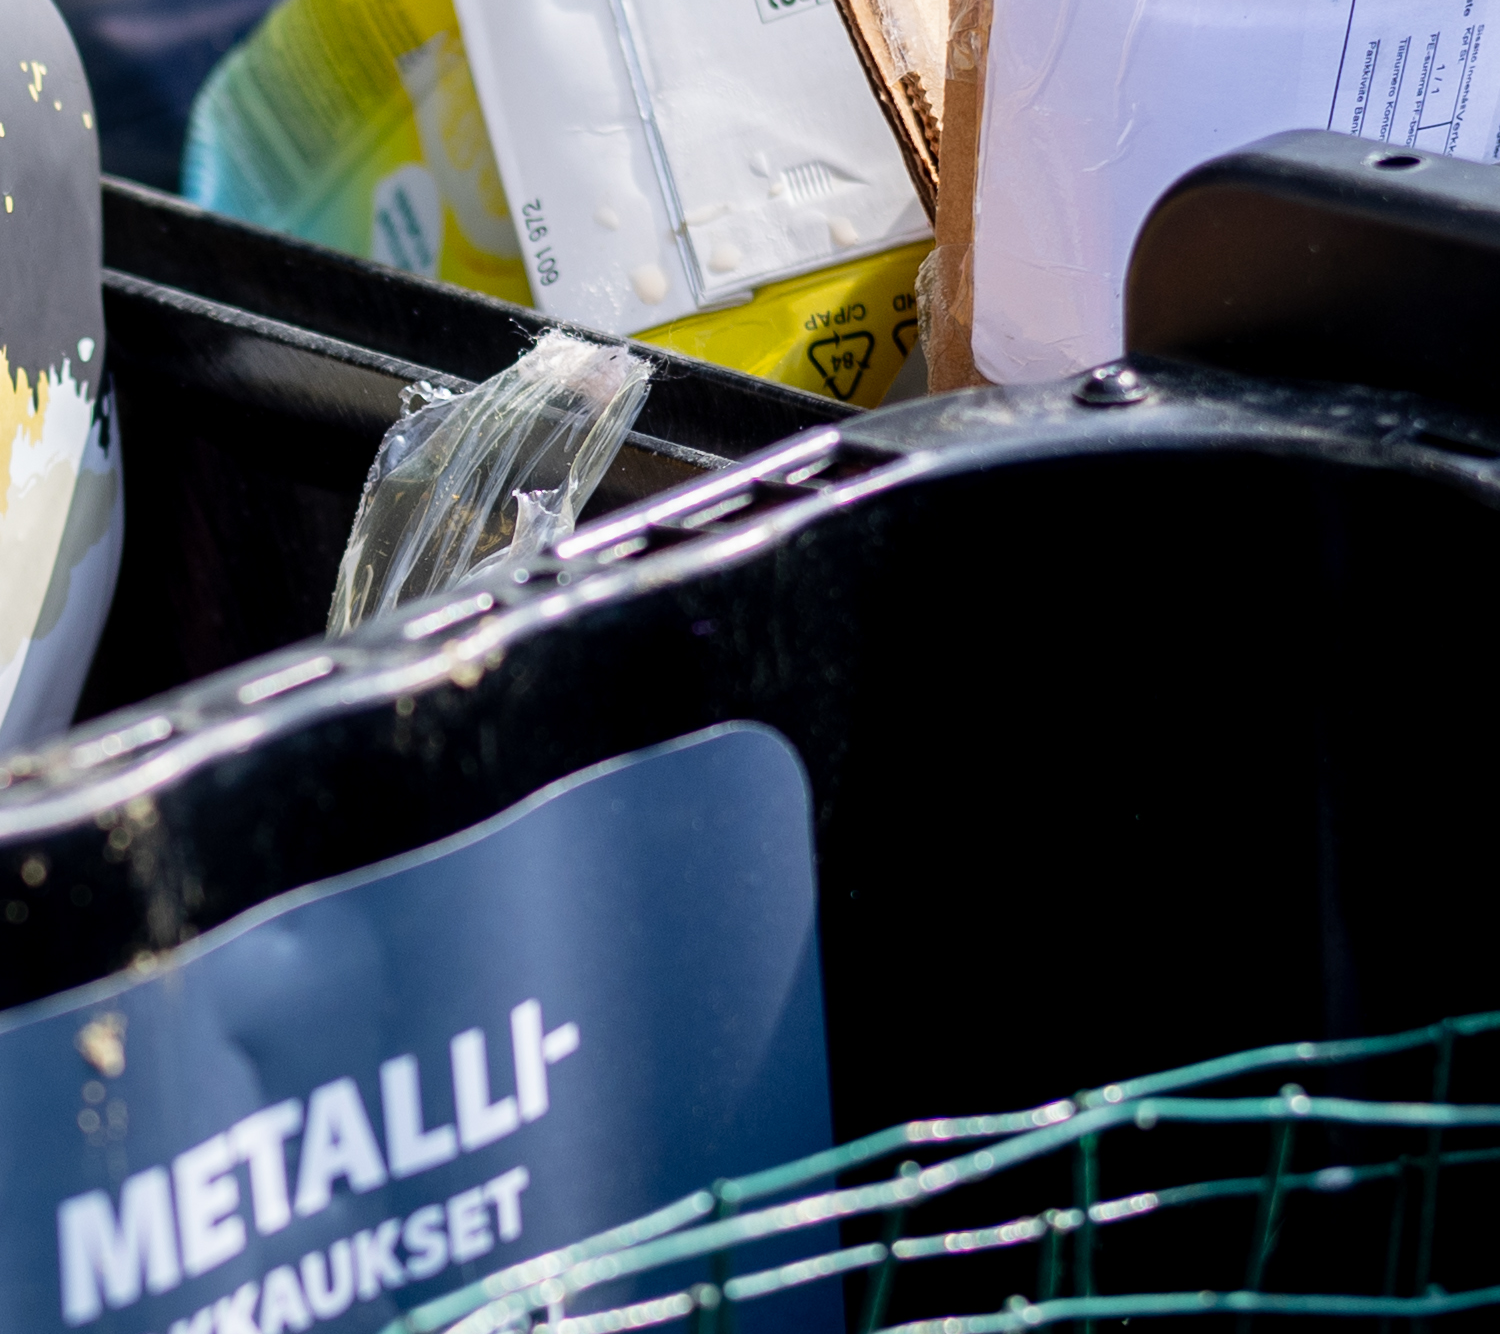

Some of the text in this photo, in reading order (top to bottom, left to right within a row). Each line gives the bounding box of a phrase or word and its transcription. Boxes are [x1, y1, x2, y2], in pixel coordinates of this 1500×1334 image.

[522, 198, 559, 287] 601 972
[804, 303, 866, 331] C/PAP
[58, 999, 582, 1329] METALLI-
